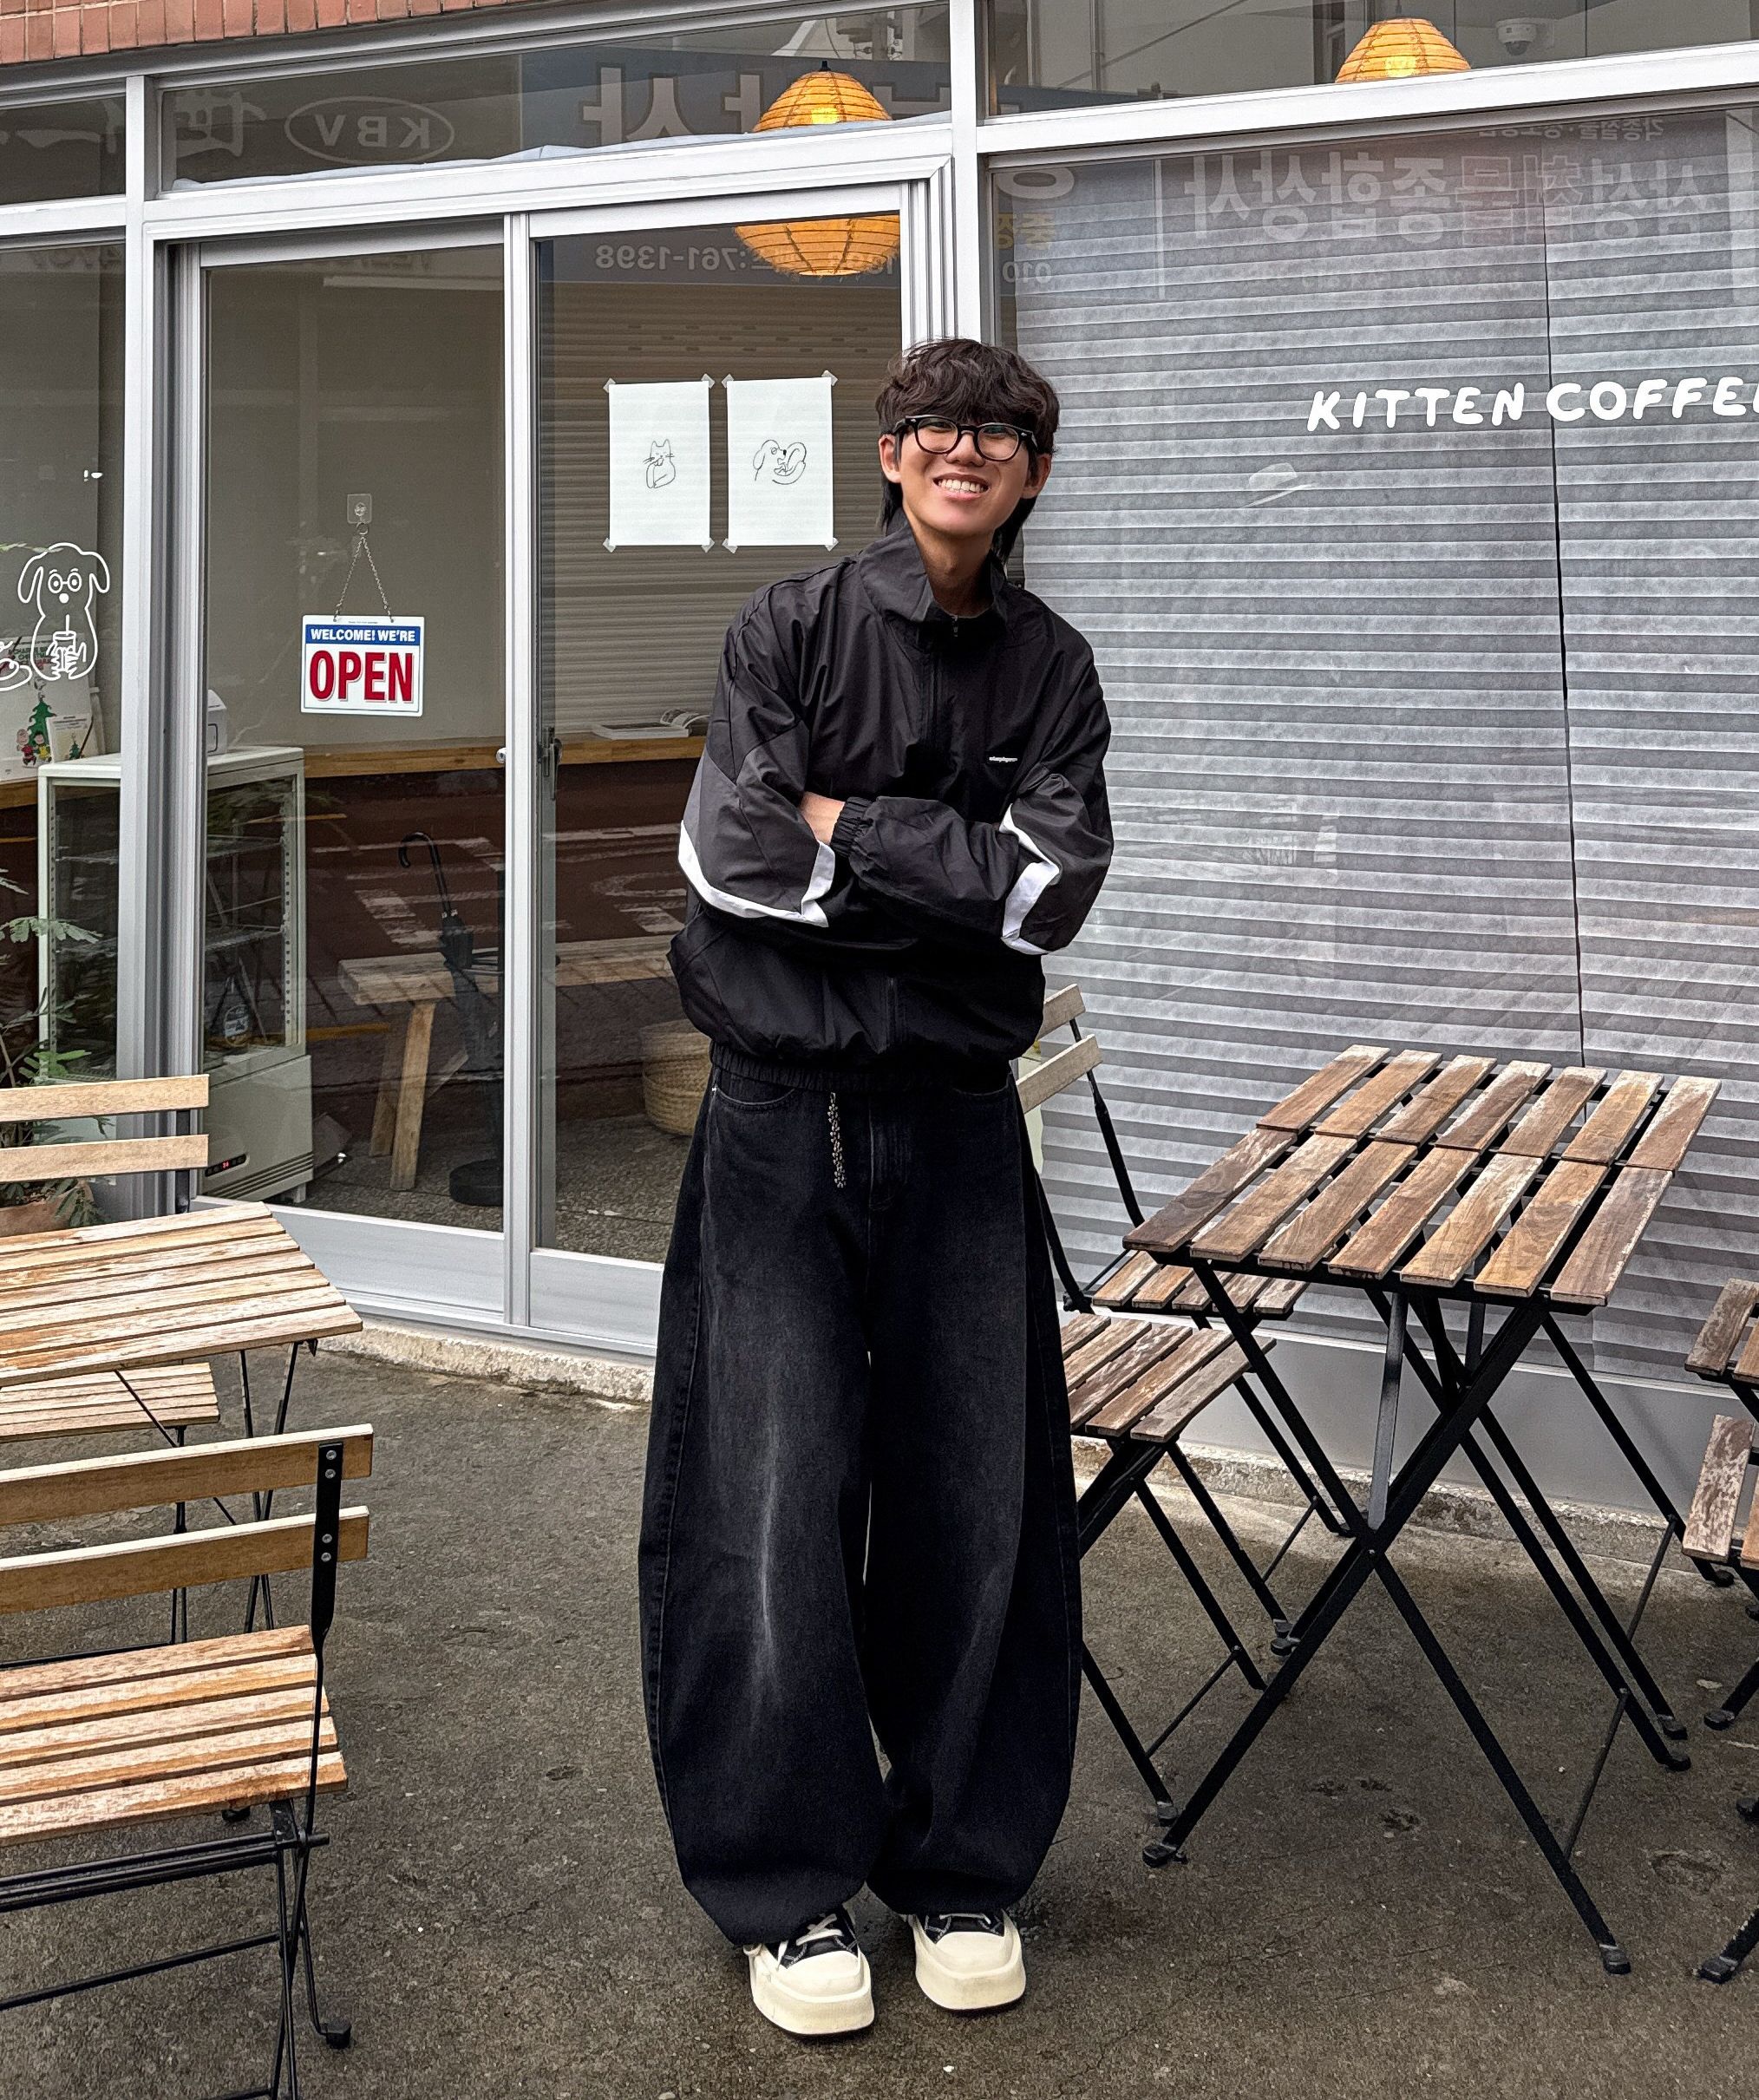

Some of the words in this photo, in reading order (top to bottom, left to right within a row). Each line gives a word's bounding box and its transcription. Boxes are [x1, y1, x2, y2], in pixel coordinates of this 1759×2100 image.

[1306, 382, 1525, 432] KITTEN
[1546, 376, 1759, 422] COFFE
[310, 628, 376, 642] WELCOME!
[377, 629, 416, 643] WE'RE
[309, 650, 415, 703] OPEN
